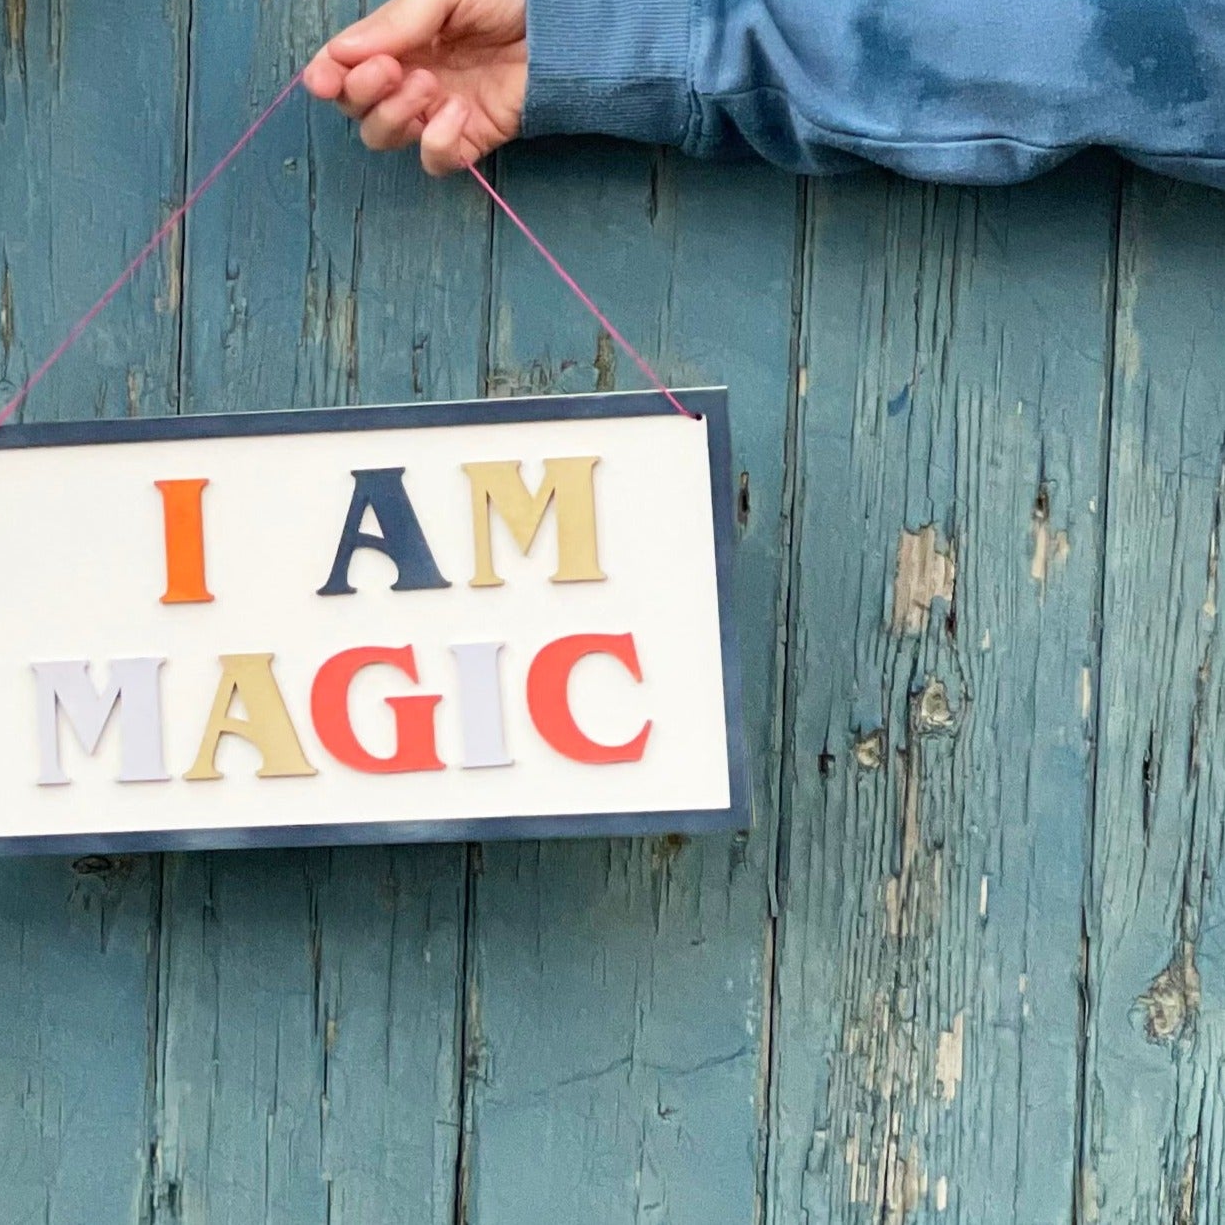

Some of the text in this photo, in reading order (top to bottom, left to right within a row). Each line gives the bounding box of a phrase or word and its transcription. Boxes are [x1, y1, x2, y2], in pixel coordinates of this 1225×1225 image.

[153, 455, 609, 604] I AM
[30, 632, 652, 787] MAGIC
